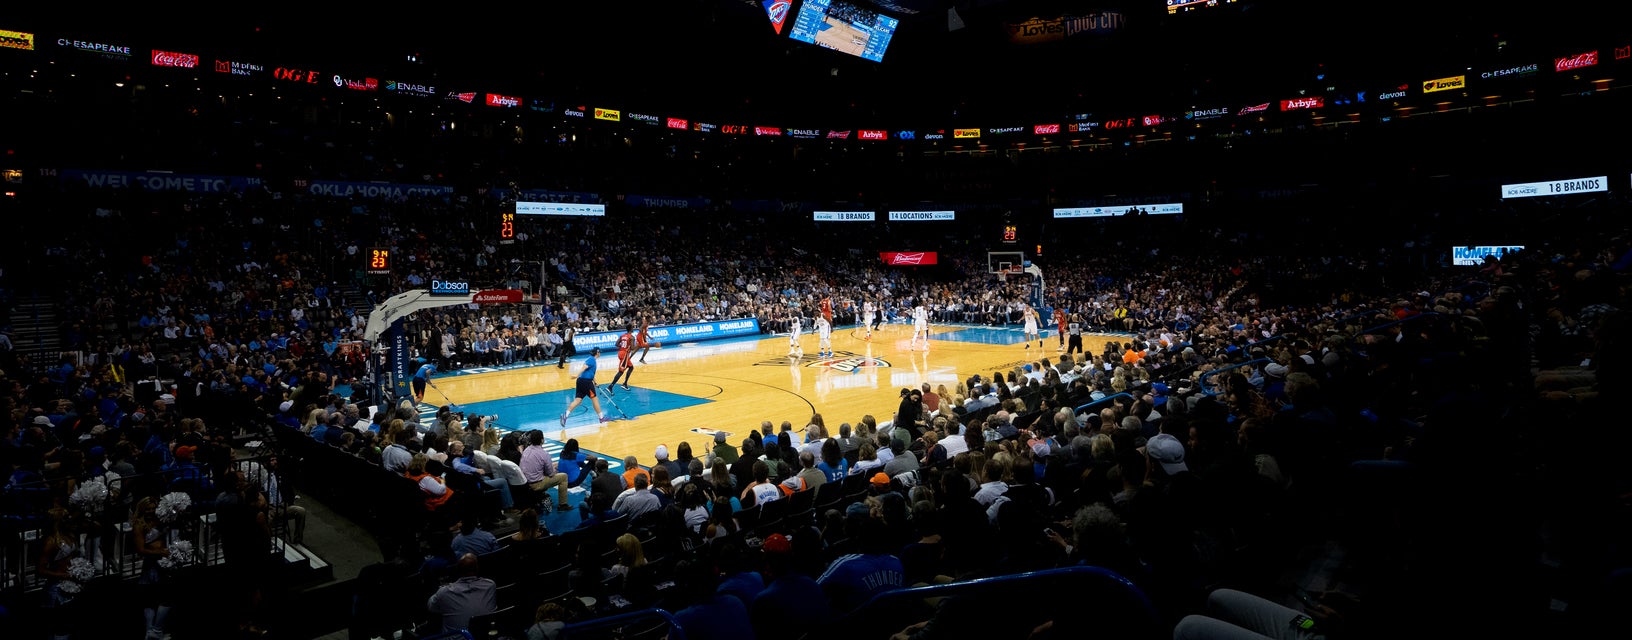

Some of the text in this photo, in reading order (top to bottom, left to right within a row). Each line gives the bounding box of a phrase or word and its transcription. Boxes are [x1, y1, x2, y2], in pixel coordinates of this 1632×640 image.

[57, 38, 131, 54] CHESAPEAKE
[1481, 64, 1538, 79] CHESAPEAKE
[398, 82, 436, 94] ENABLE
[1379, 91, 1406, 100] devon
[493, 96, 519, 108] Arby's
[1287, 98, 1317, 109] Arby's
[565, 109, 584, 117] devon
[629, 113, 659, 121] CHESAPEAKE
[1194, 108, 1228, 117] ENABLE
[863, 131, 883, 139] Arby's
[1549, 179, 1600, 193] 18 BRANDS
[502, 222, 513, 237] 23
[372, 257, 385, 268] 23
[432, 280, 469, 290] Dobson
[676, 324, 714, 335] HOMELAND
[720, 320, 758, 331] HOMELAND
[574, 334, 619, 345] HOMELAND
[862, 570, 903, 591] THUNDER
